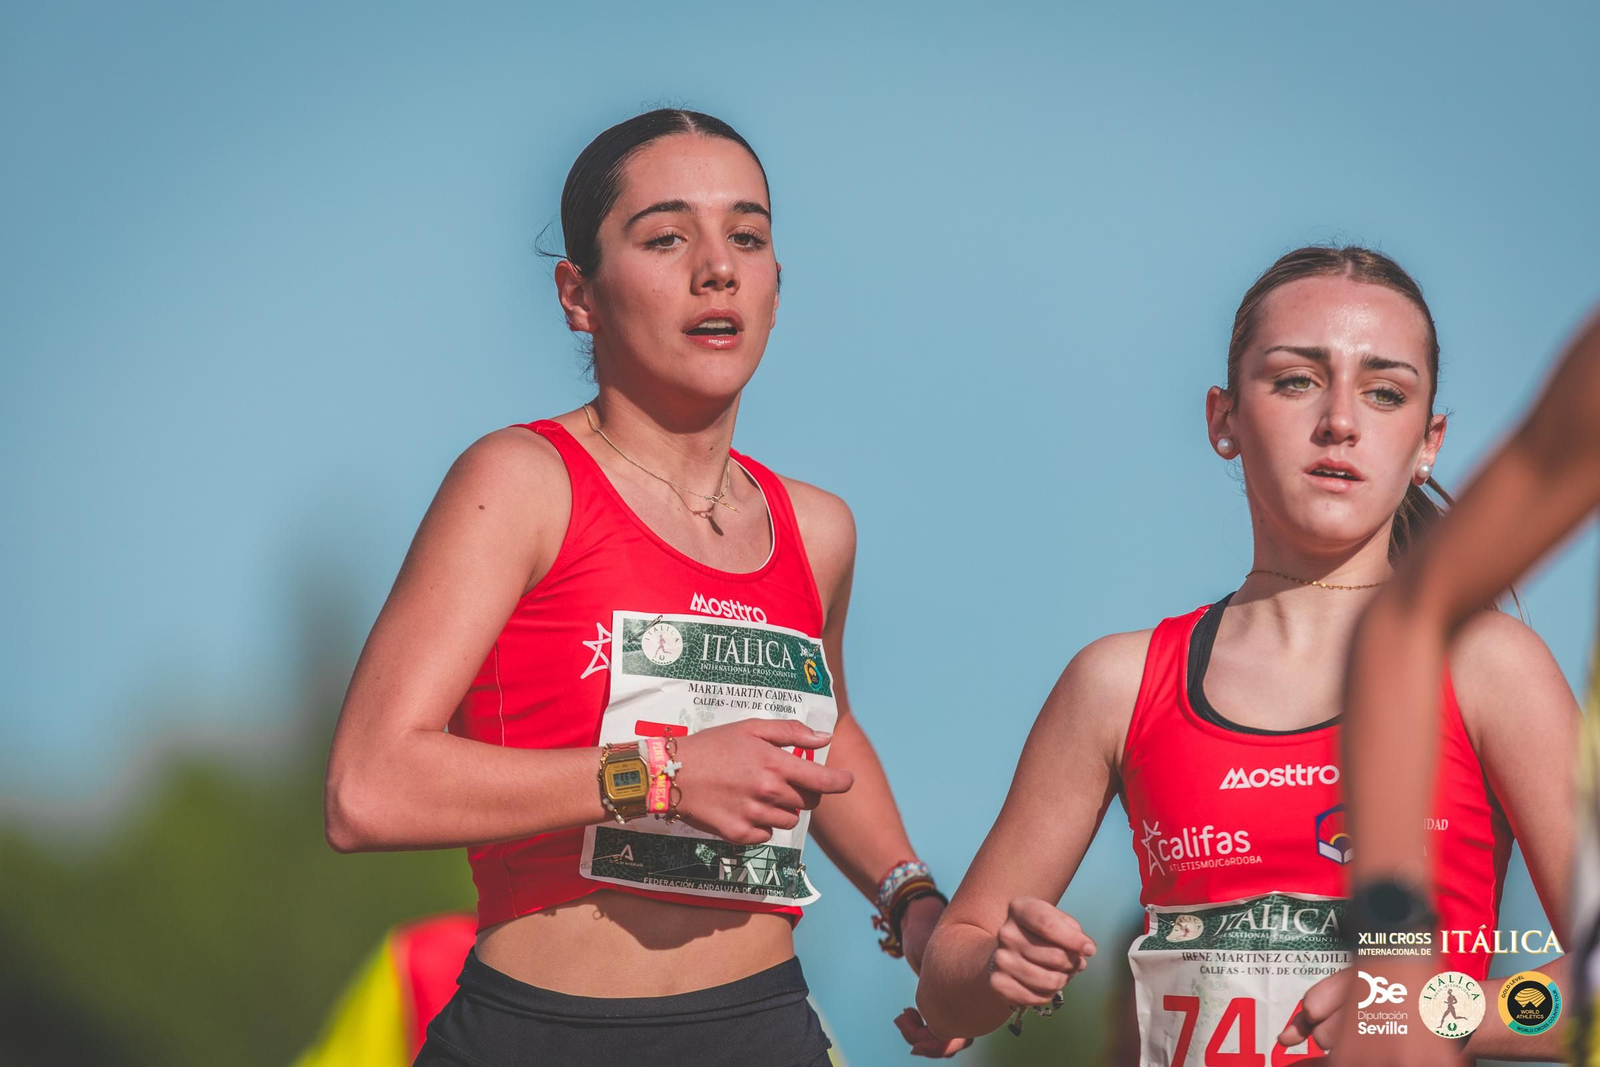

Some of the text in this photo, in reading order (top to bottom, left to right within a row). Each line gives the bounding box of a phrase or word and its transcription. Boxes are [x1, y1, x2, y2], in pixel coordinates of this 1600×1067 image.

[690, 591, 767, 624] Mosttro
[700, 629, 796, 671] ITÁLICA
[688, 682, 803, 703] MARTA MARTÍN CADENAS
[693, 696, 726, 707] CALIFAS
[730, 700, 751, 710] UNIV.
[752, 701, 763, 711] DE
[764, 701, 797, 714] CÓRDOBA
[1219, 764, 1340, 790] Mosttro
[1158, 825, 1251, 862] califas
[643, 877, 785, 897] FEDERACIÓN ANDALUZA DE ATLETISMO
[1182, 951, 1356, 964] IRENE MARTINEZ CAÑADILL
[1200, 965, 1239, 975] CALIFAS
[1247, 966, 1274, 976] UNIV.
[1277, 966, 1291, 976] DE
